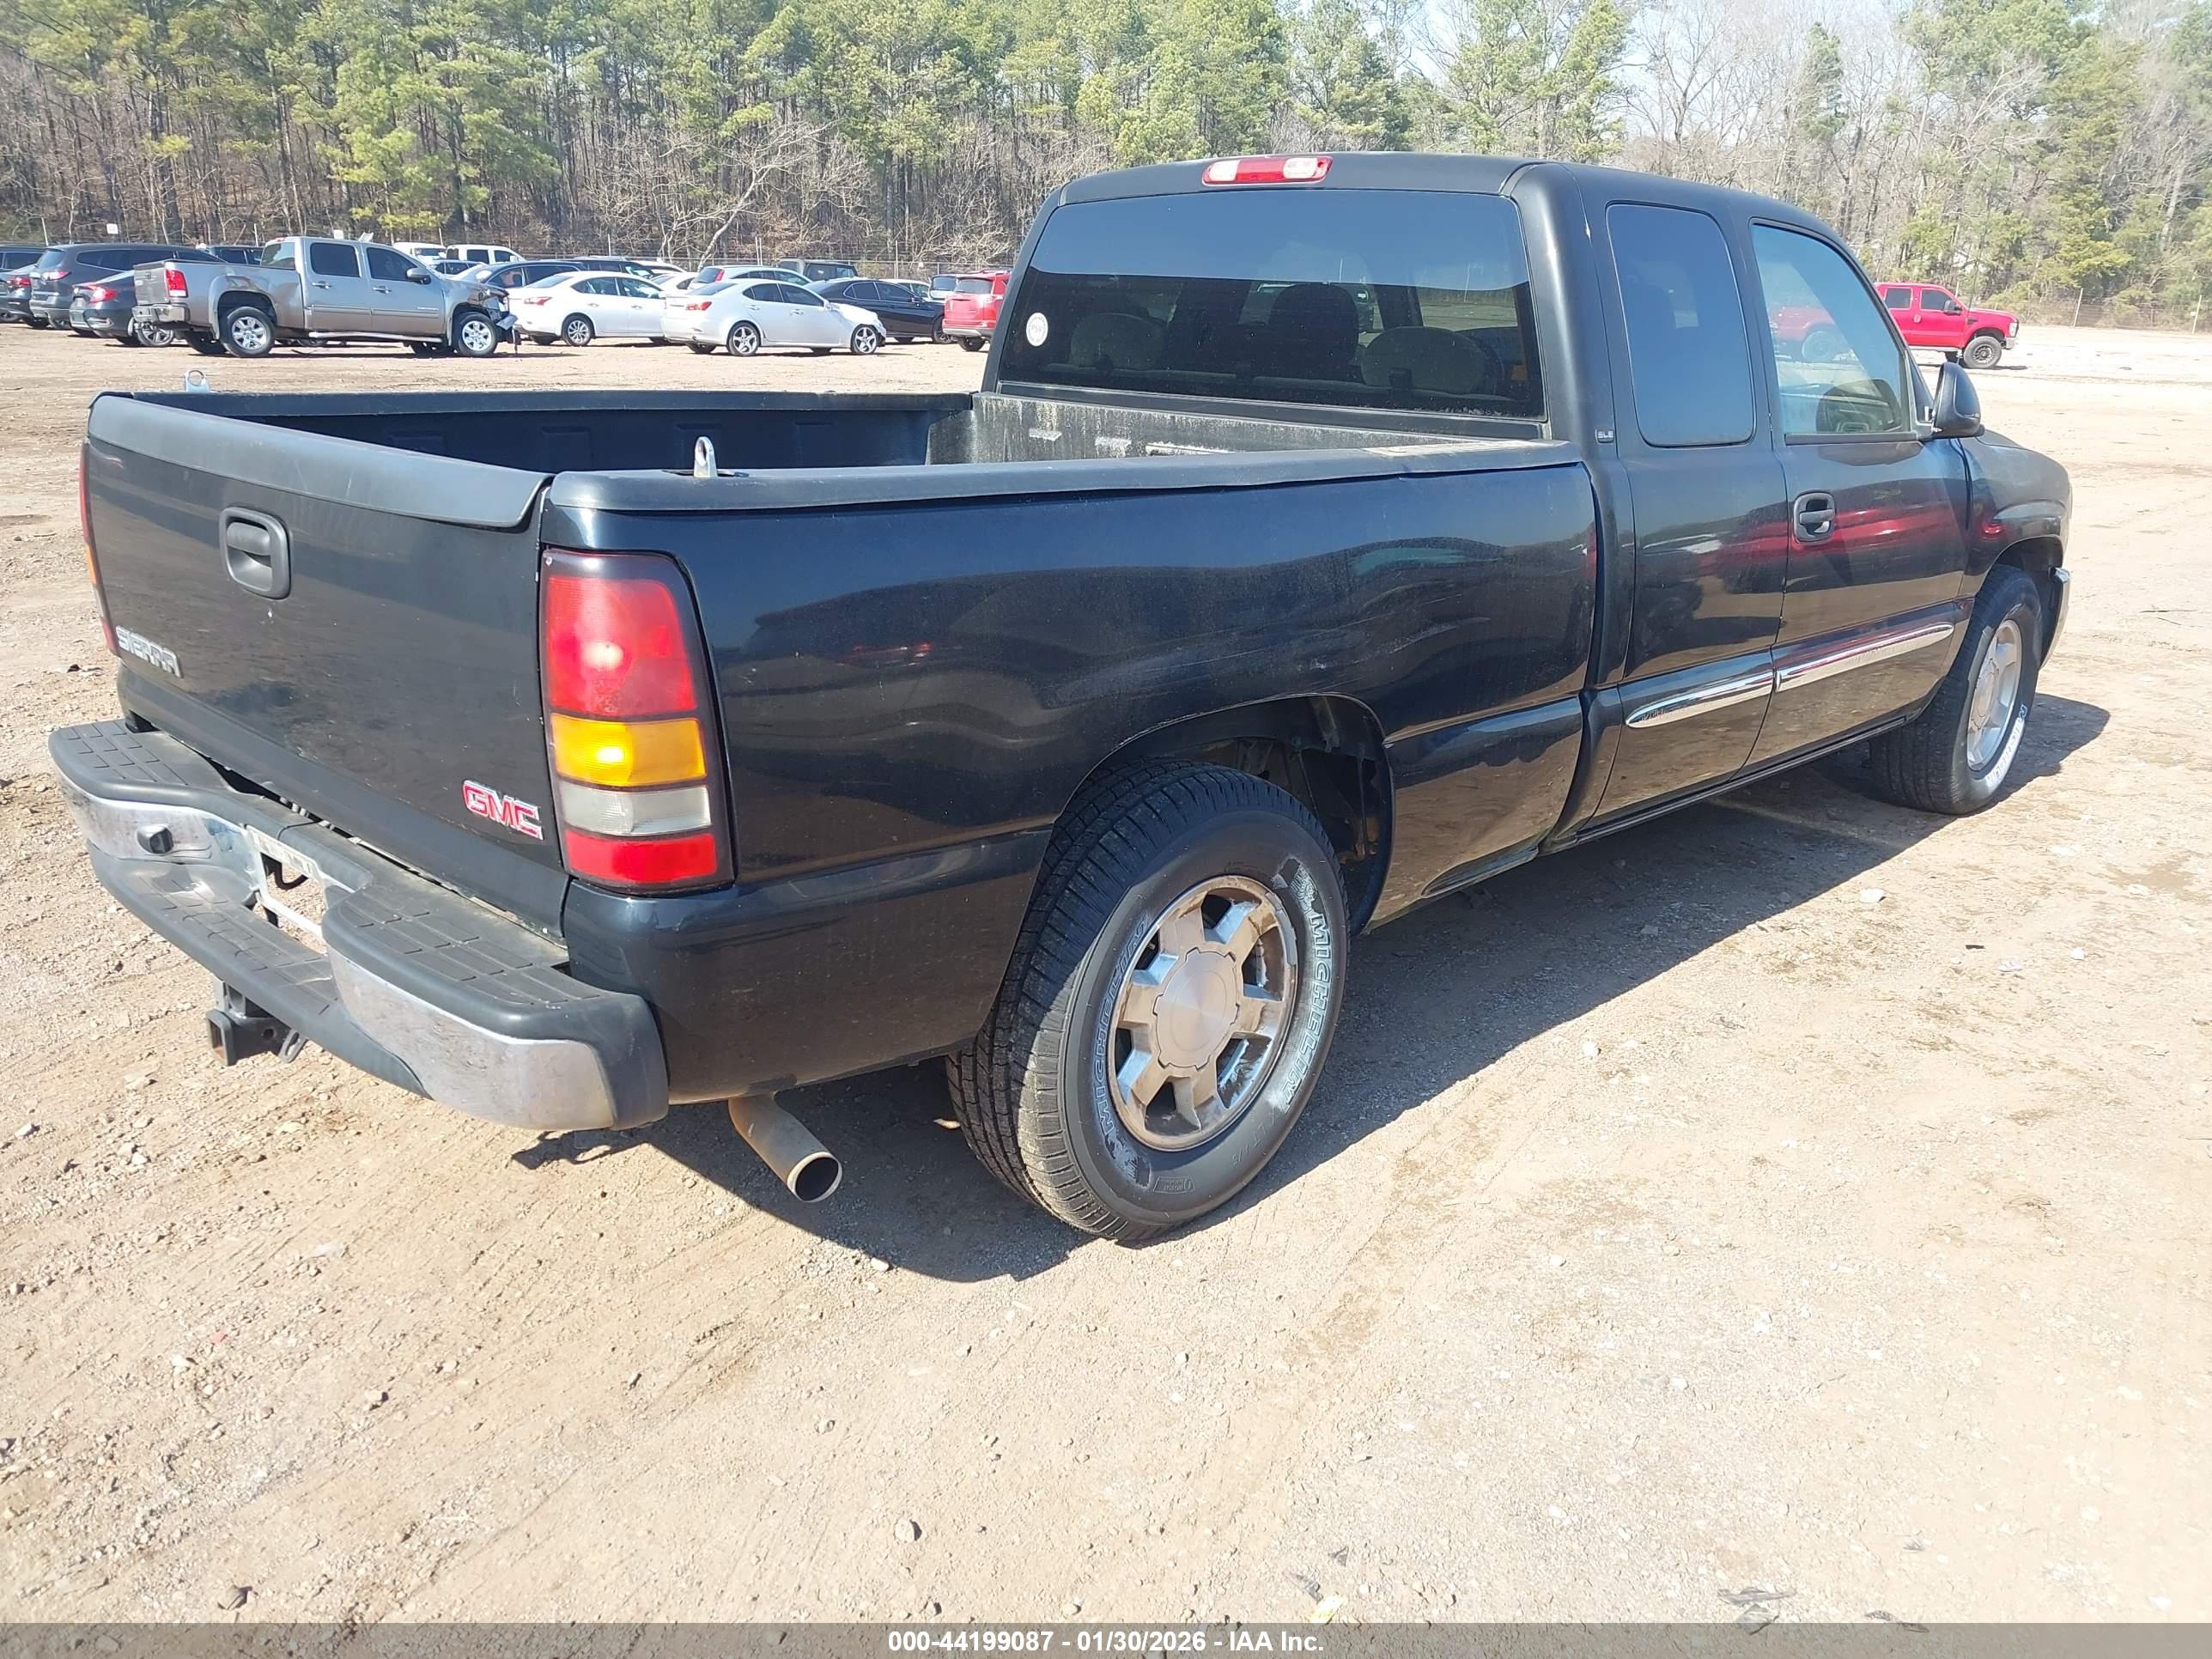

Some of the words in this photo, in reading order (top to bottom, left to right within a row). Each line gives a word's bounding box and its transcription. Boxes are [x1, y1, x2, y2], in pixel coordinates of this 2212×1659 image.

[115, 627, 181, 678] SIERRA
[462, 779, 544, 841] GMC
[1094, 913, 1152, 1137] MICHELIN
[1279, 913, 1331, 1114] MICHELIN
